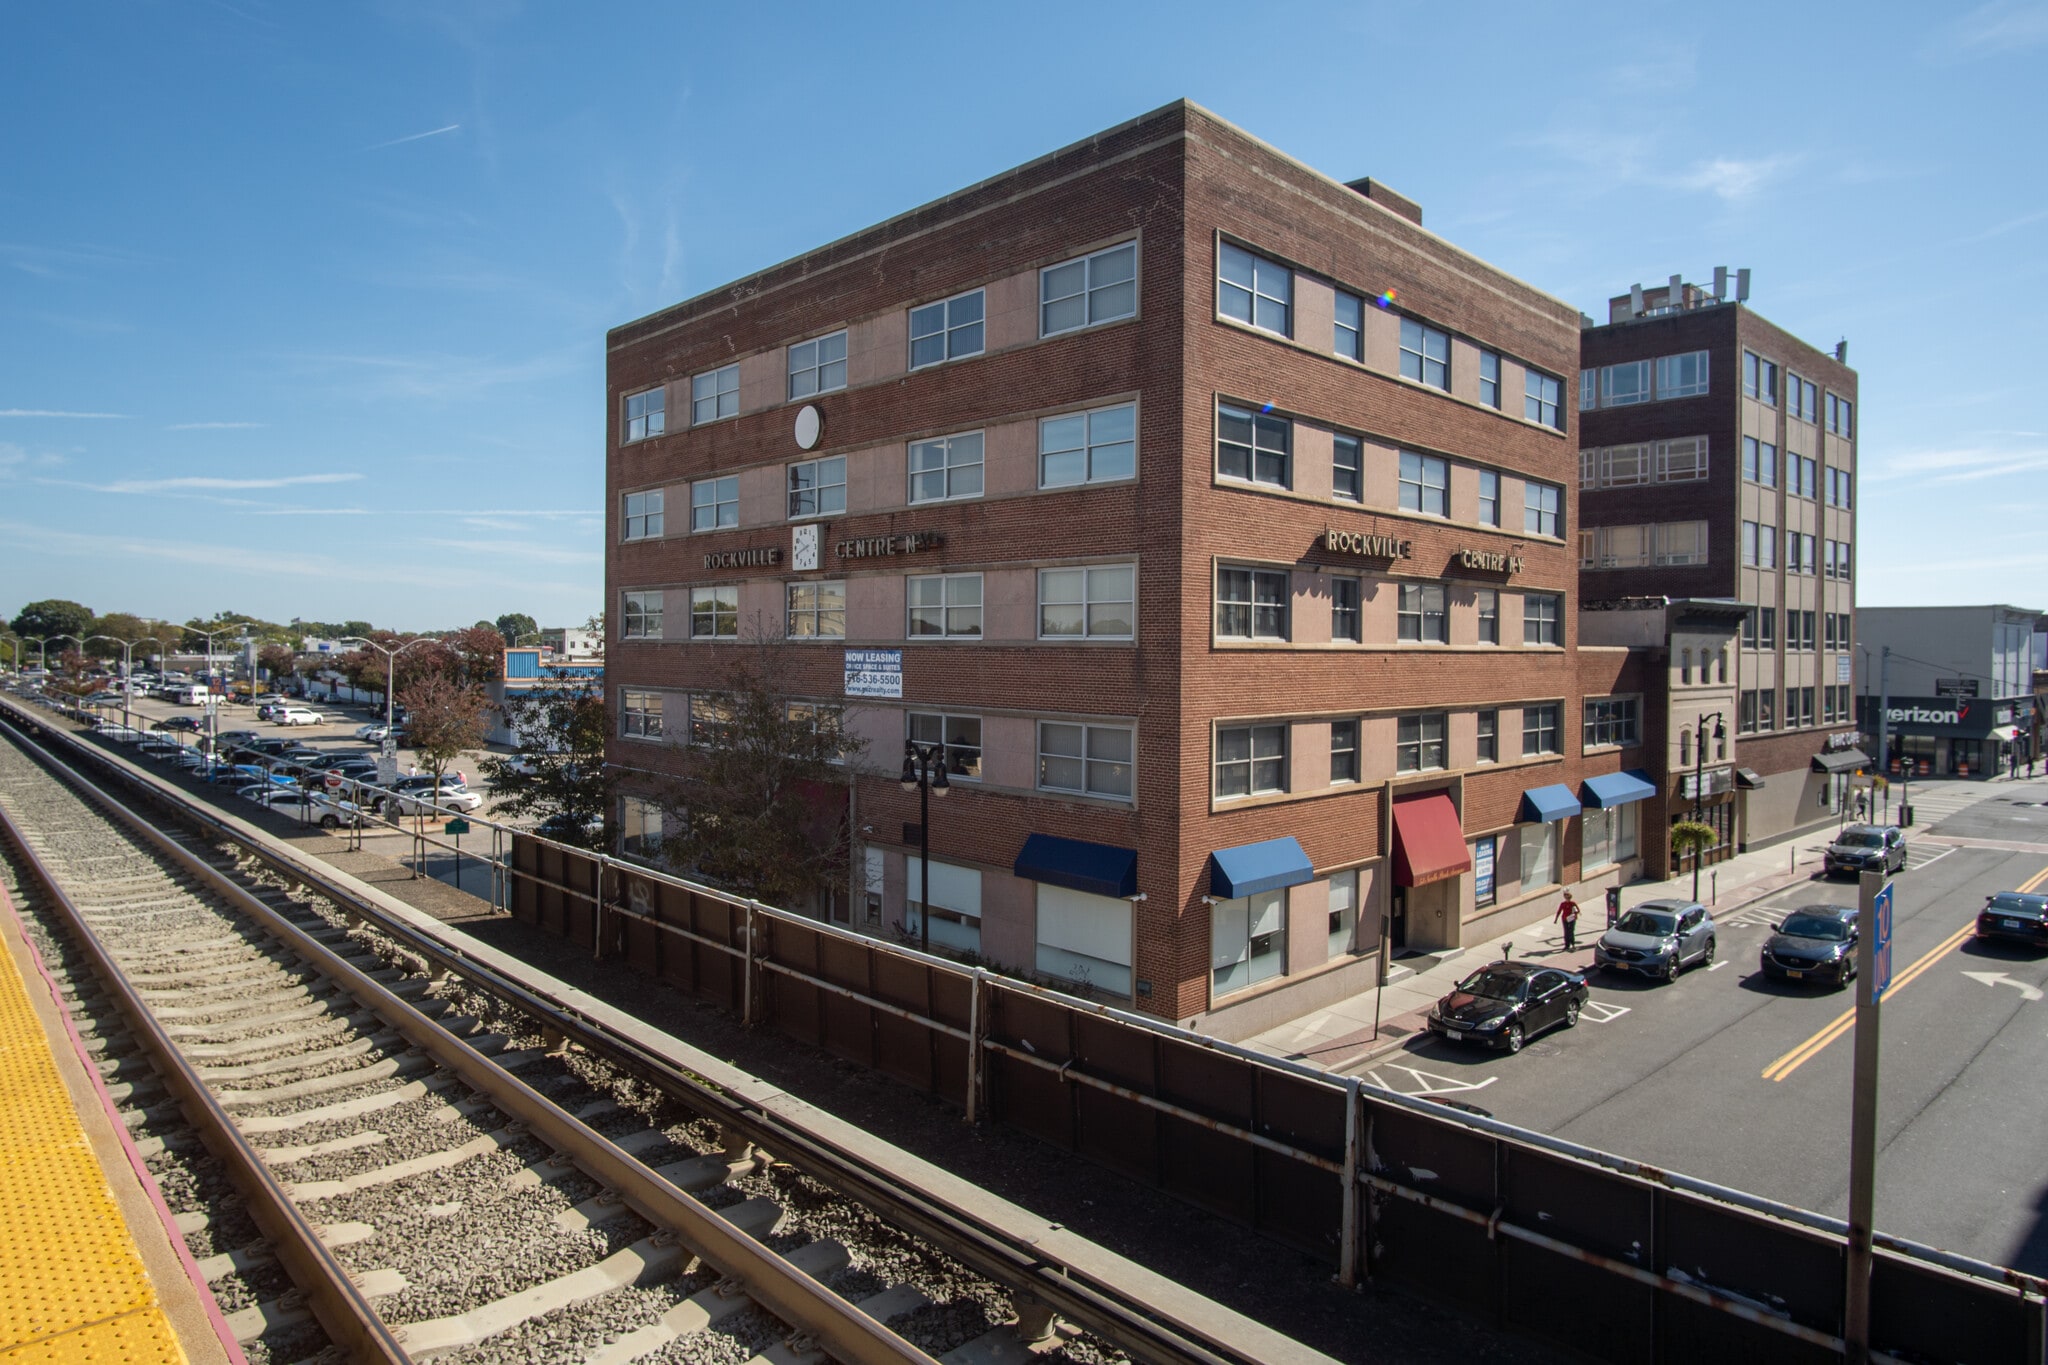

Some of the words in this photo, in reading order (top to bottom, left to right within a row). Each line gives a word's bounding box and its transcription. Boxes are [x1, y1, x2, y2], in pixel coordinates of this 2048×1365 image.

[834, 537, 896, 558] CENTRE
[1327, 529, 1412, 560] ROCKVILLE
[704, 548, 778, 569] ROCKVILLE
[1462, 549, 1505, 572] CENTRE
[846, 652, 864, 662] NOW
[865, 652, 901, 663] LEASING
[1878, 898, 1890, 943] 10
